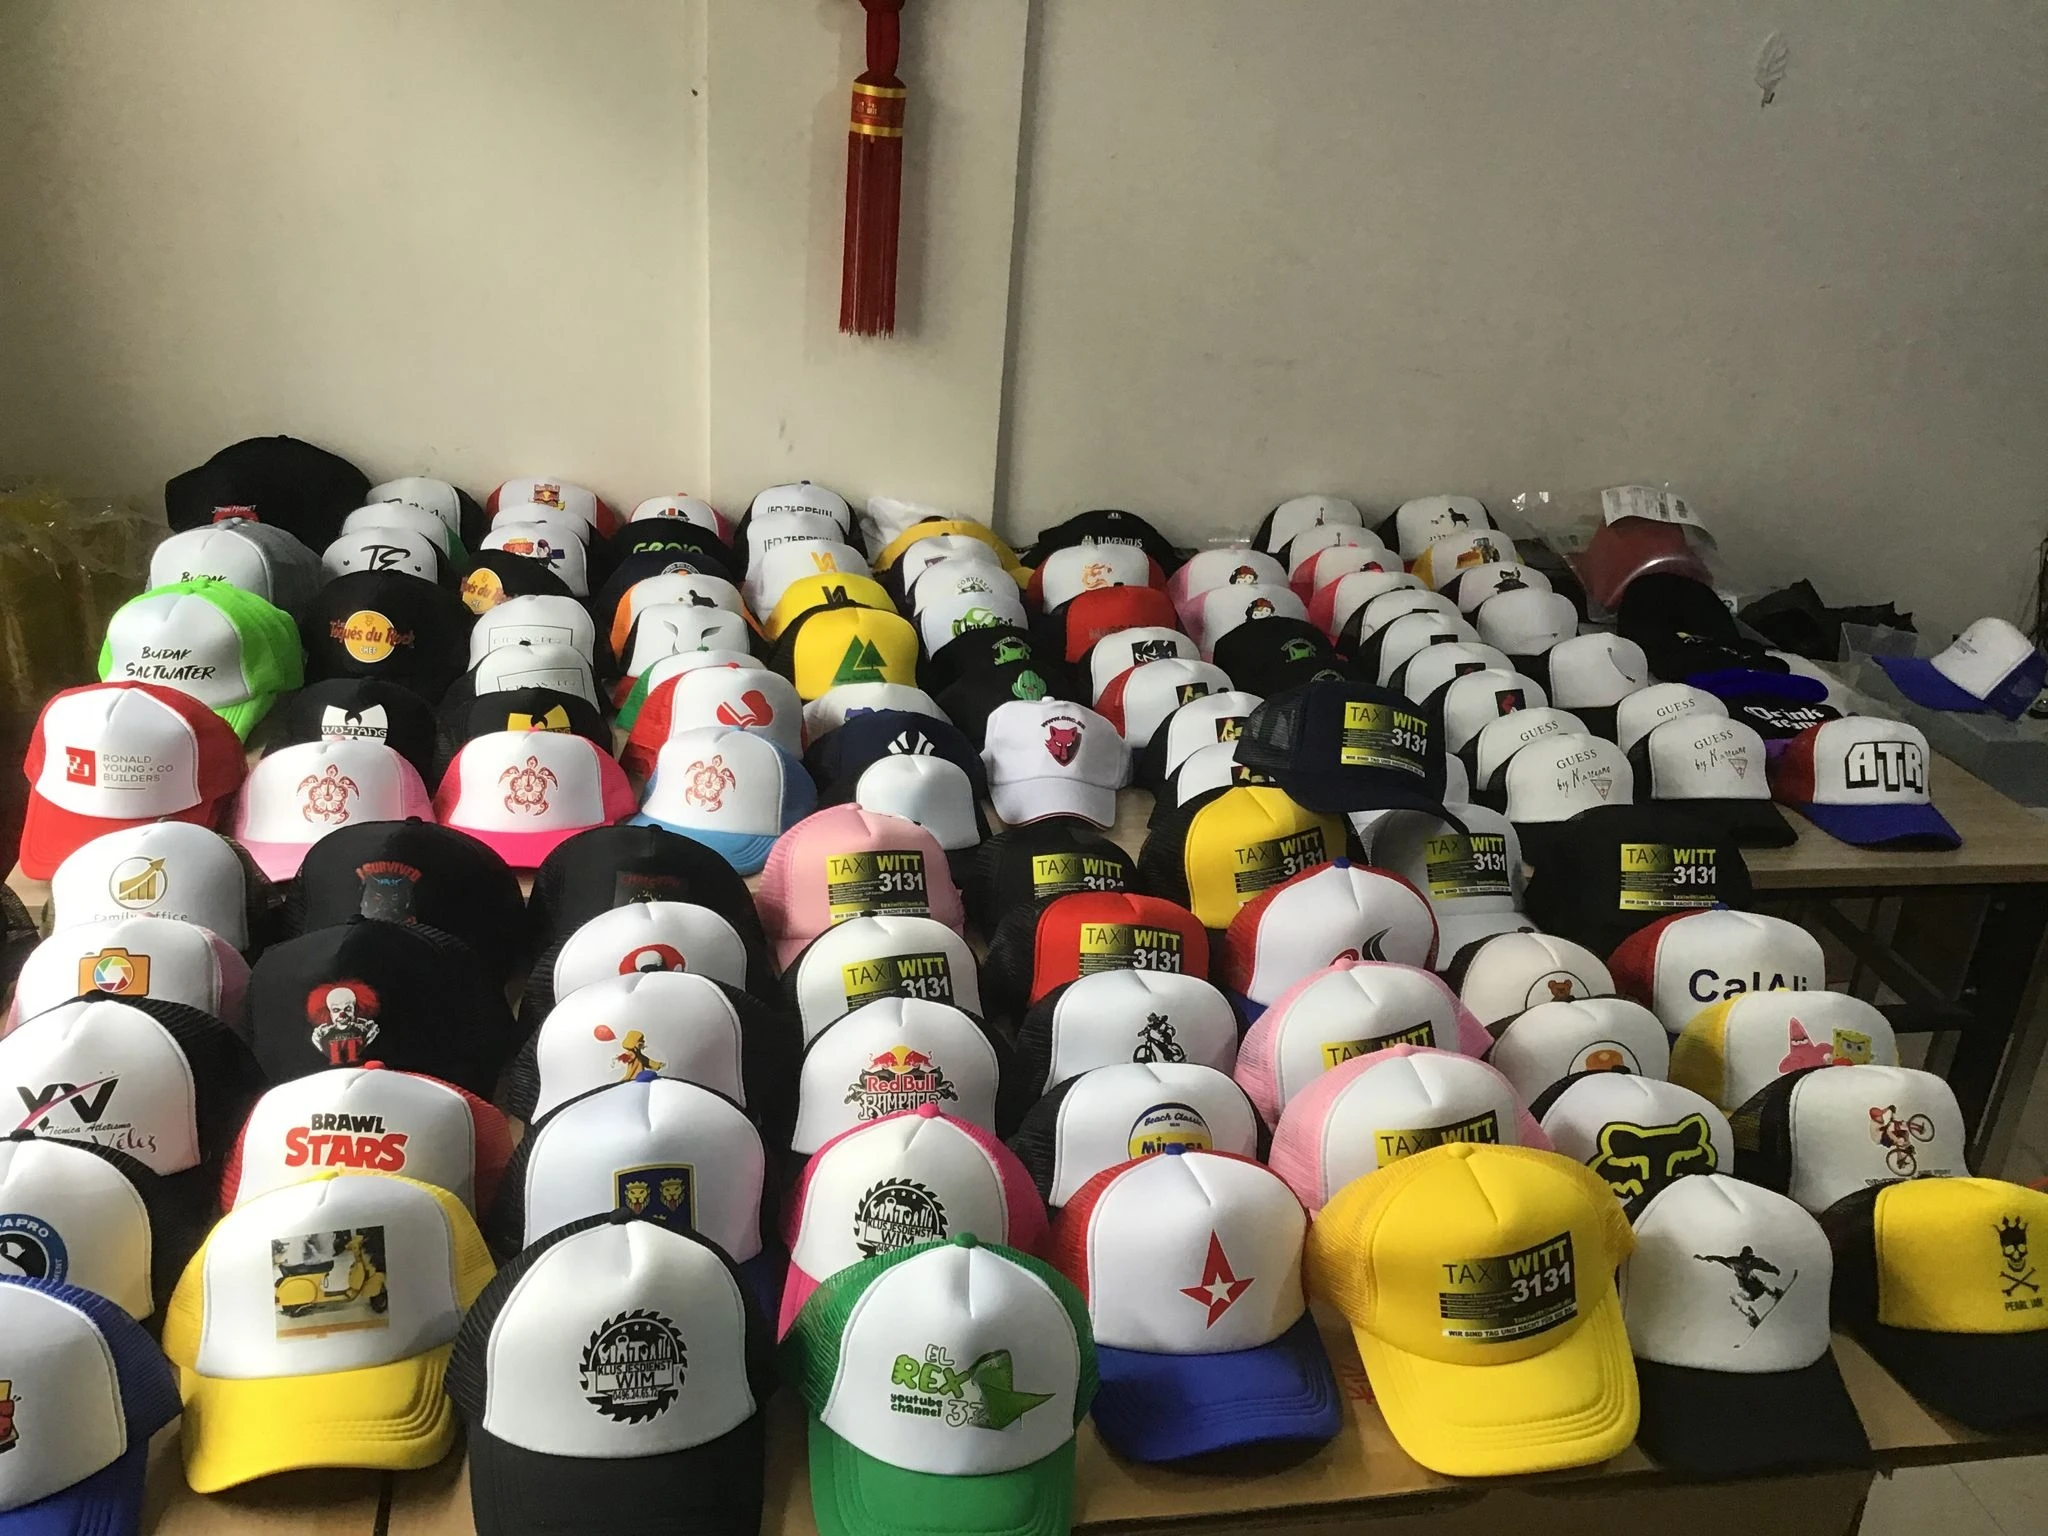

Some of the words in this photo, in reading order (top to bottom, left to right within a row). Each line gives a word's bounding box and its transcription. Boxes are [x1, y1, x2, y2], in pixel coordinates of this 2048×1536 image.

[365, 626, 383, 643] du
[141, 646, 192, 661] BUDAK
[125, 662, 216, 681] SALTWATER
[1656, 698, 1696, 717] GUESS
[321, 726, 387, 738] WU-TANG
[1393, 711, 1428, 736] WITT
[1520, 720, 1559, 742] GUESS
[1391, 728, 1427, 756] 3131
[1694, 729, 1734, 750] GUESS
[103, 754, 151, 763] RONALD
[103, 764, 145, 773] YOUNG
[156, 765, 174, 773] CO
[1556, 749, 1598, 769] GUESS
[103, 773, 160, 782] BUILDERS
[1280, 831, 1320, 857] WITT
[1470, 836, 1504, 852] WITT
[830, 857, 872, 876] TAXI
[876, 854, 920, 872] WITT
[1283, 848, 1325, 876] 3131
[1473, 853, 1506, 872] 3131
[1673, 848, 1717, 865] WITT
[1037, 858, 1077, 876] TAXI
[1082, 858, 1122, 879] WITT
[1673, 865, 1717, 885] 3131
[879, 872, 924, 893] 3131
[1085, 927, 1129, 945] TAXI
[1133, 928, 1181, 952] WITT
[1132, 948, 1181, 973] 3131
[848, 963, 892, 986] TAXI
[897, 957, 945, 978] WITT
[901, 976, 950, 998] 3131
[329, 1036, 363, 1065] IT
[866, 1073, 901, 1093] Red
[902, 1073, 936, 1093] Bull
[47, 1126, 81, 1136] Técnica
[86, 1122, 132, 1133] Atletismo
[311, 1113, 387, 1134] BRAWL
[1144, 1112, 1172, 1126] Beach
[284, 1126, 409, 1172] STARS
[867, 1219, 932, 1238] KLUSJESDIENST
[881, 1230, 915, 1247] WIM
[1508, 1239, 1567, 1279] WITT
[1511, 1261, 1571, 1303] 3131
[925, 1344, 955, 1366] EL
[598, 1360, 672, 1376] KLUSJESDIENST
[891, 1354, 970, 1398] REX
[616, 1371, 655, 1389] WIM
[891, 1393, 943, 1407] youtube
[891, 1403, 942, 1417] channel
